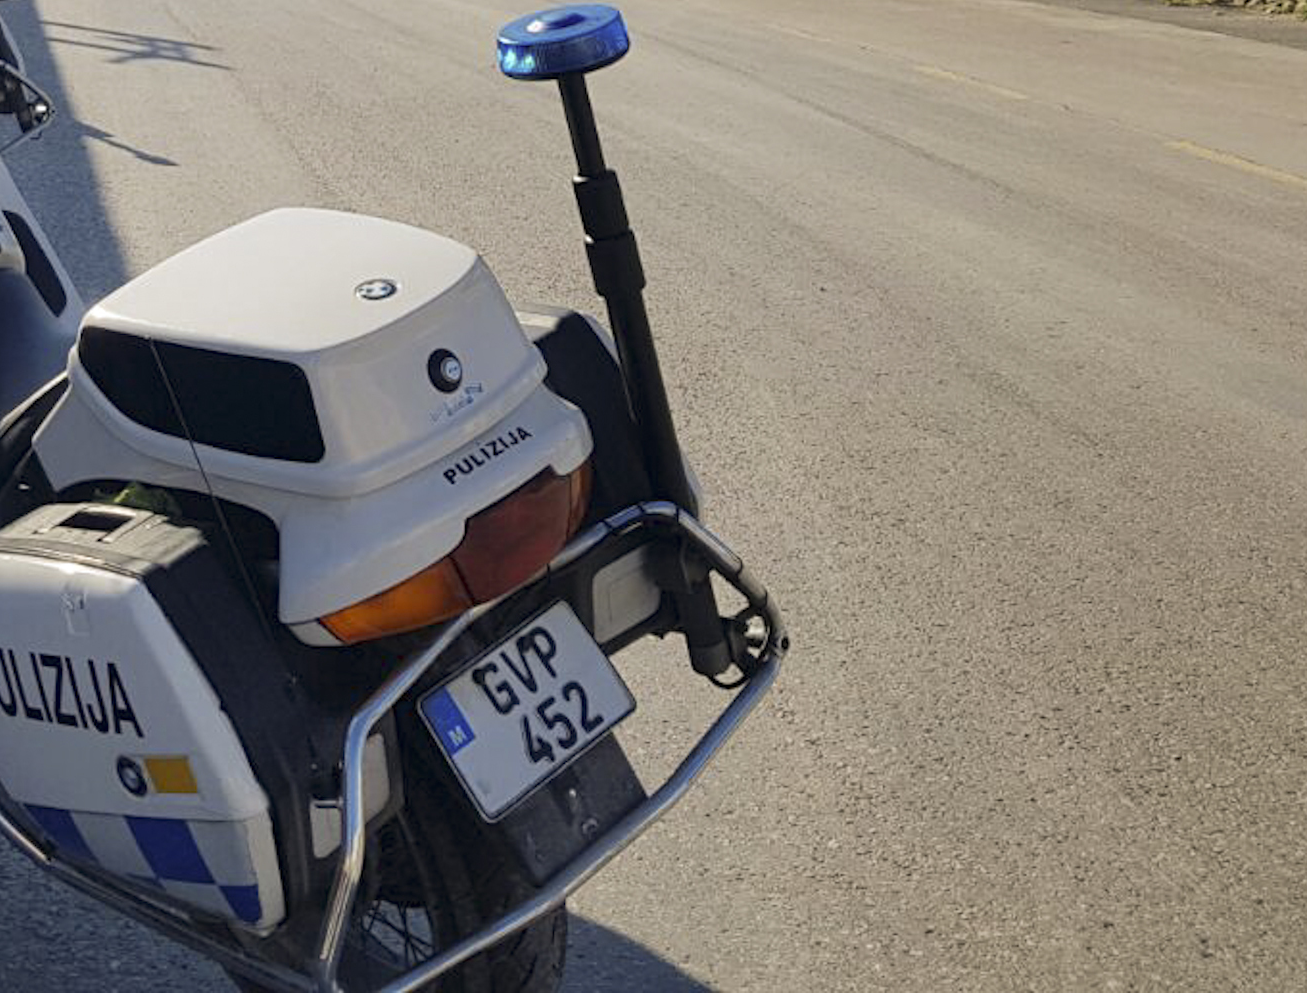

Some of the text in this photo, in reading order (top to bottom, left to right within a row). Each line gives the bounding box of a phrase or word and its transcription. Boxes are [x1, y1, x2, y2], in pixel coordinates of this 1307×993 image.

[442, 425, 534, 485] PULIZIJA
[471, 626, 557, 715] GVP
[520, 681, 605, 764] 452
